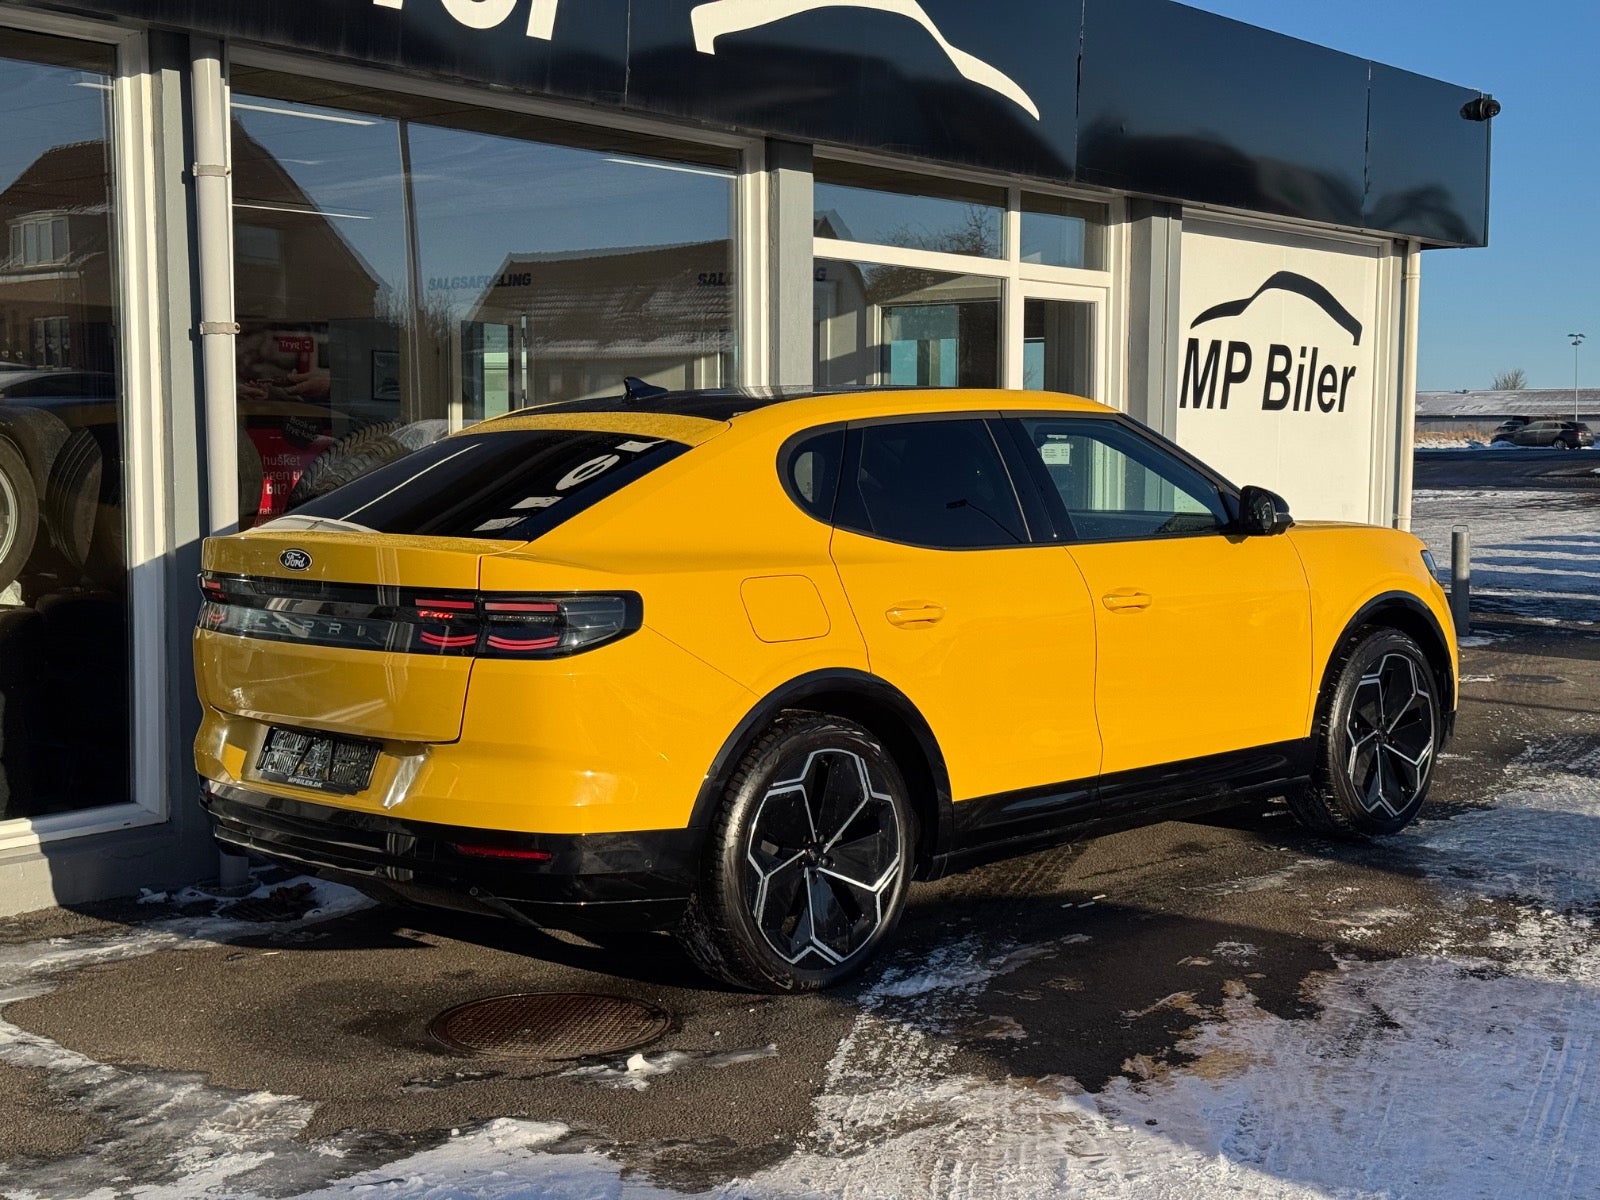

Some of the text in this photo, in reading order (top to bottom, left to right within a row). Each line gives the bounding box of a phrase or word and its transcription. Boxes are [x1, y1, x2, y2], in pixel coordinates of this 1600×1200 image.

[1179, 337, 1357, 414] MP Biler
[263, 454, 301, 466] husket
[266, 483, 288, 495] bil?
[284, 551, 305, 568] Ford
[253, 614, 364, 638] CAPRI
